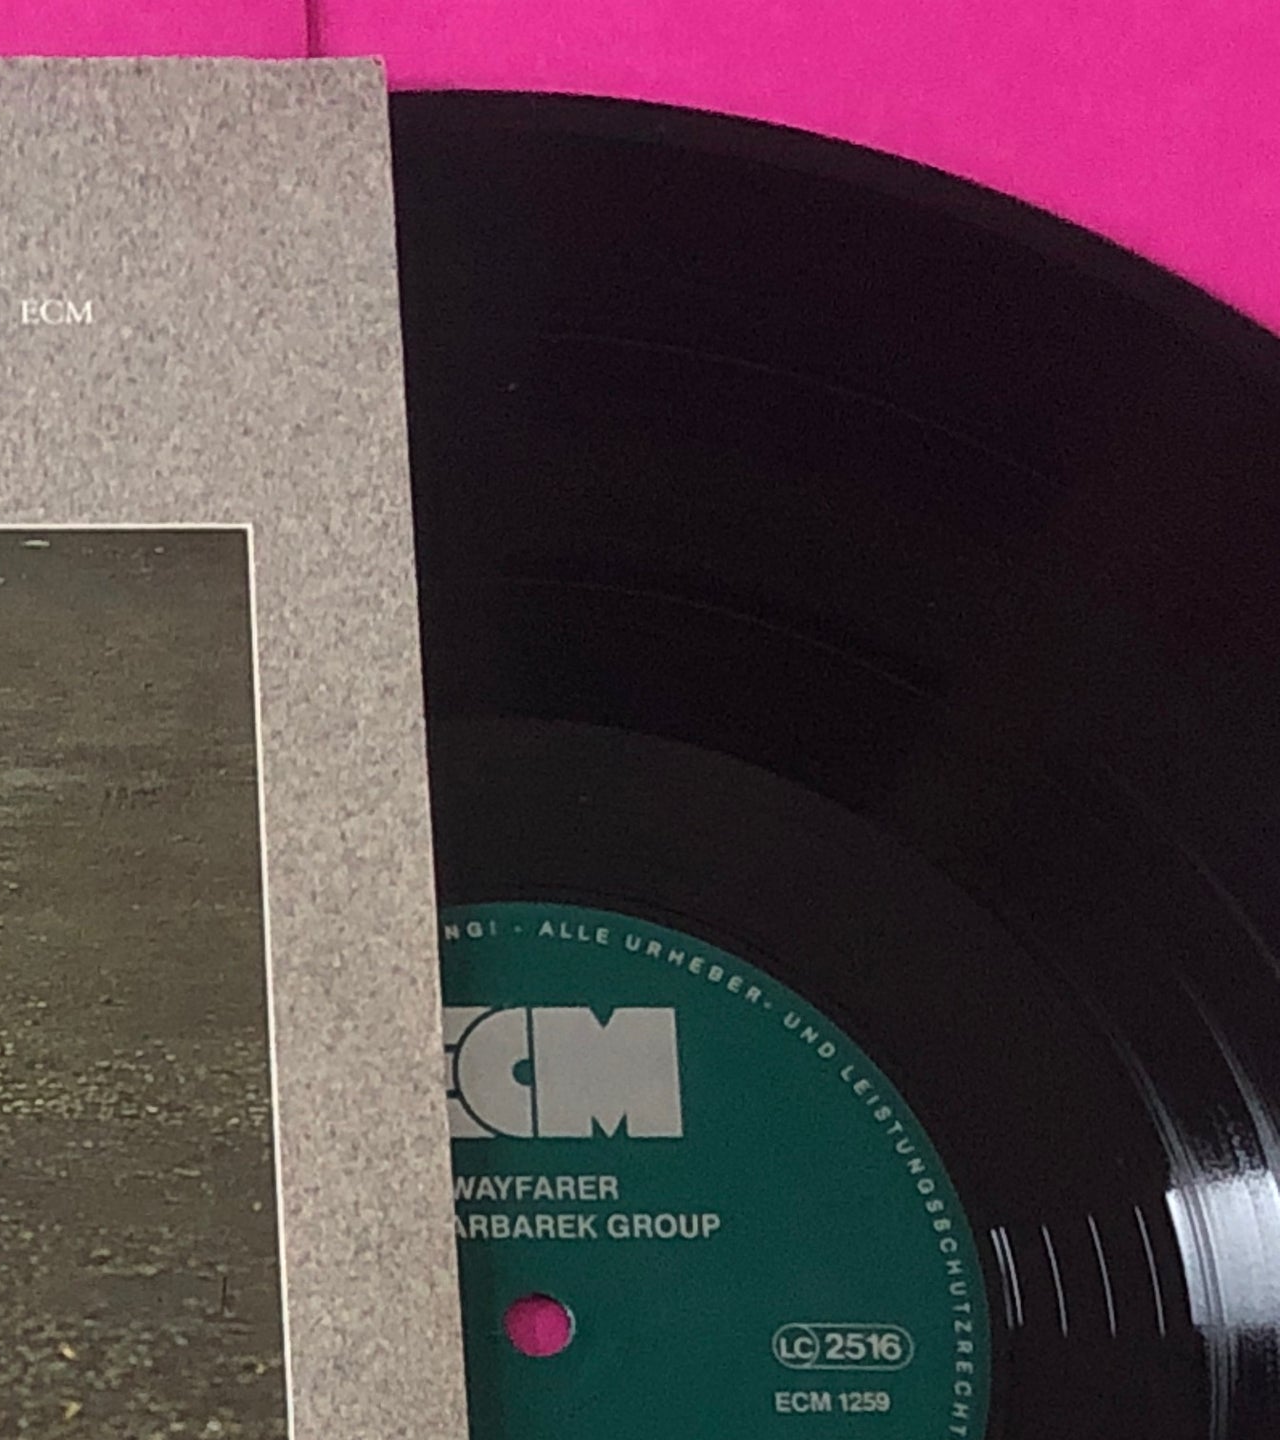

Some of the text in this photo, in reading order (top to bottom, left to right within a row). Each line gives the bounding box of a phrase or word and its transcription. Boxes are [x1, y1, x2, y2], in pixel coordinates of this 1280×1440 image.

[21, 299, 94, 325] ECM
[444, 921, 496, 940] NG!
[538, 920, 610, 945] ALLE
[783, 1011, 837, 1059] UND
[453, 1175, 620, 1201] WAYFARER
[453, 1213, 722, 1239] ARBAREK GROUP
[779, 1332, 903, 1361] LC 2516
[774, 1391, 891, 1413] ECM 1259
